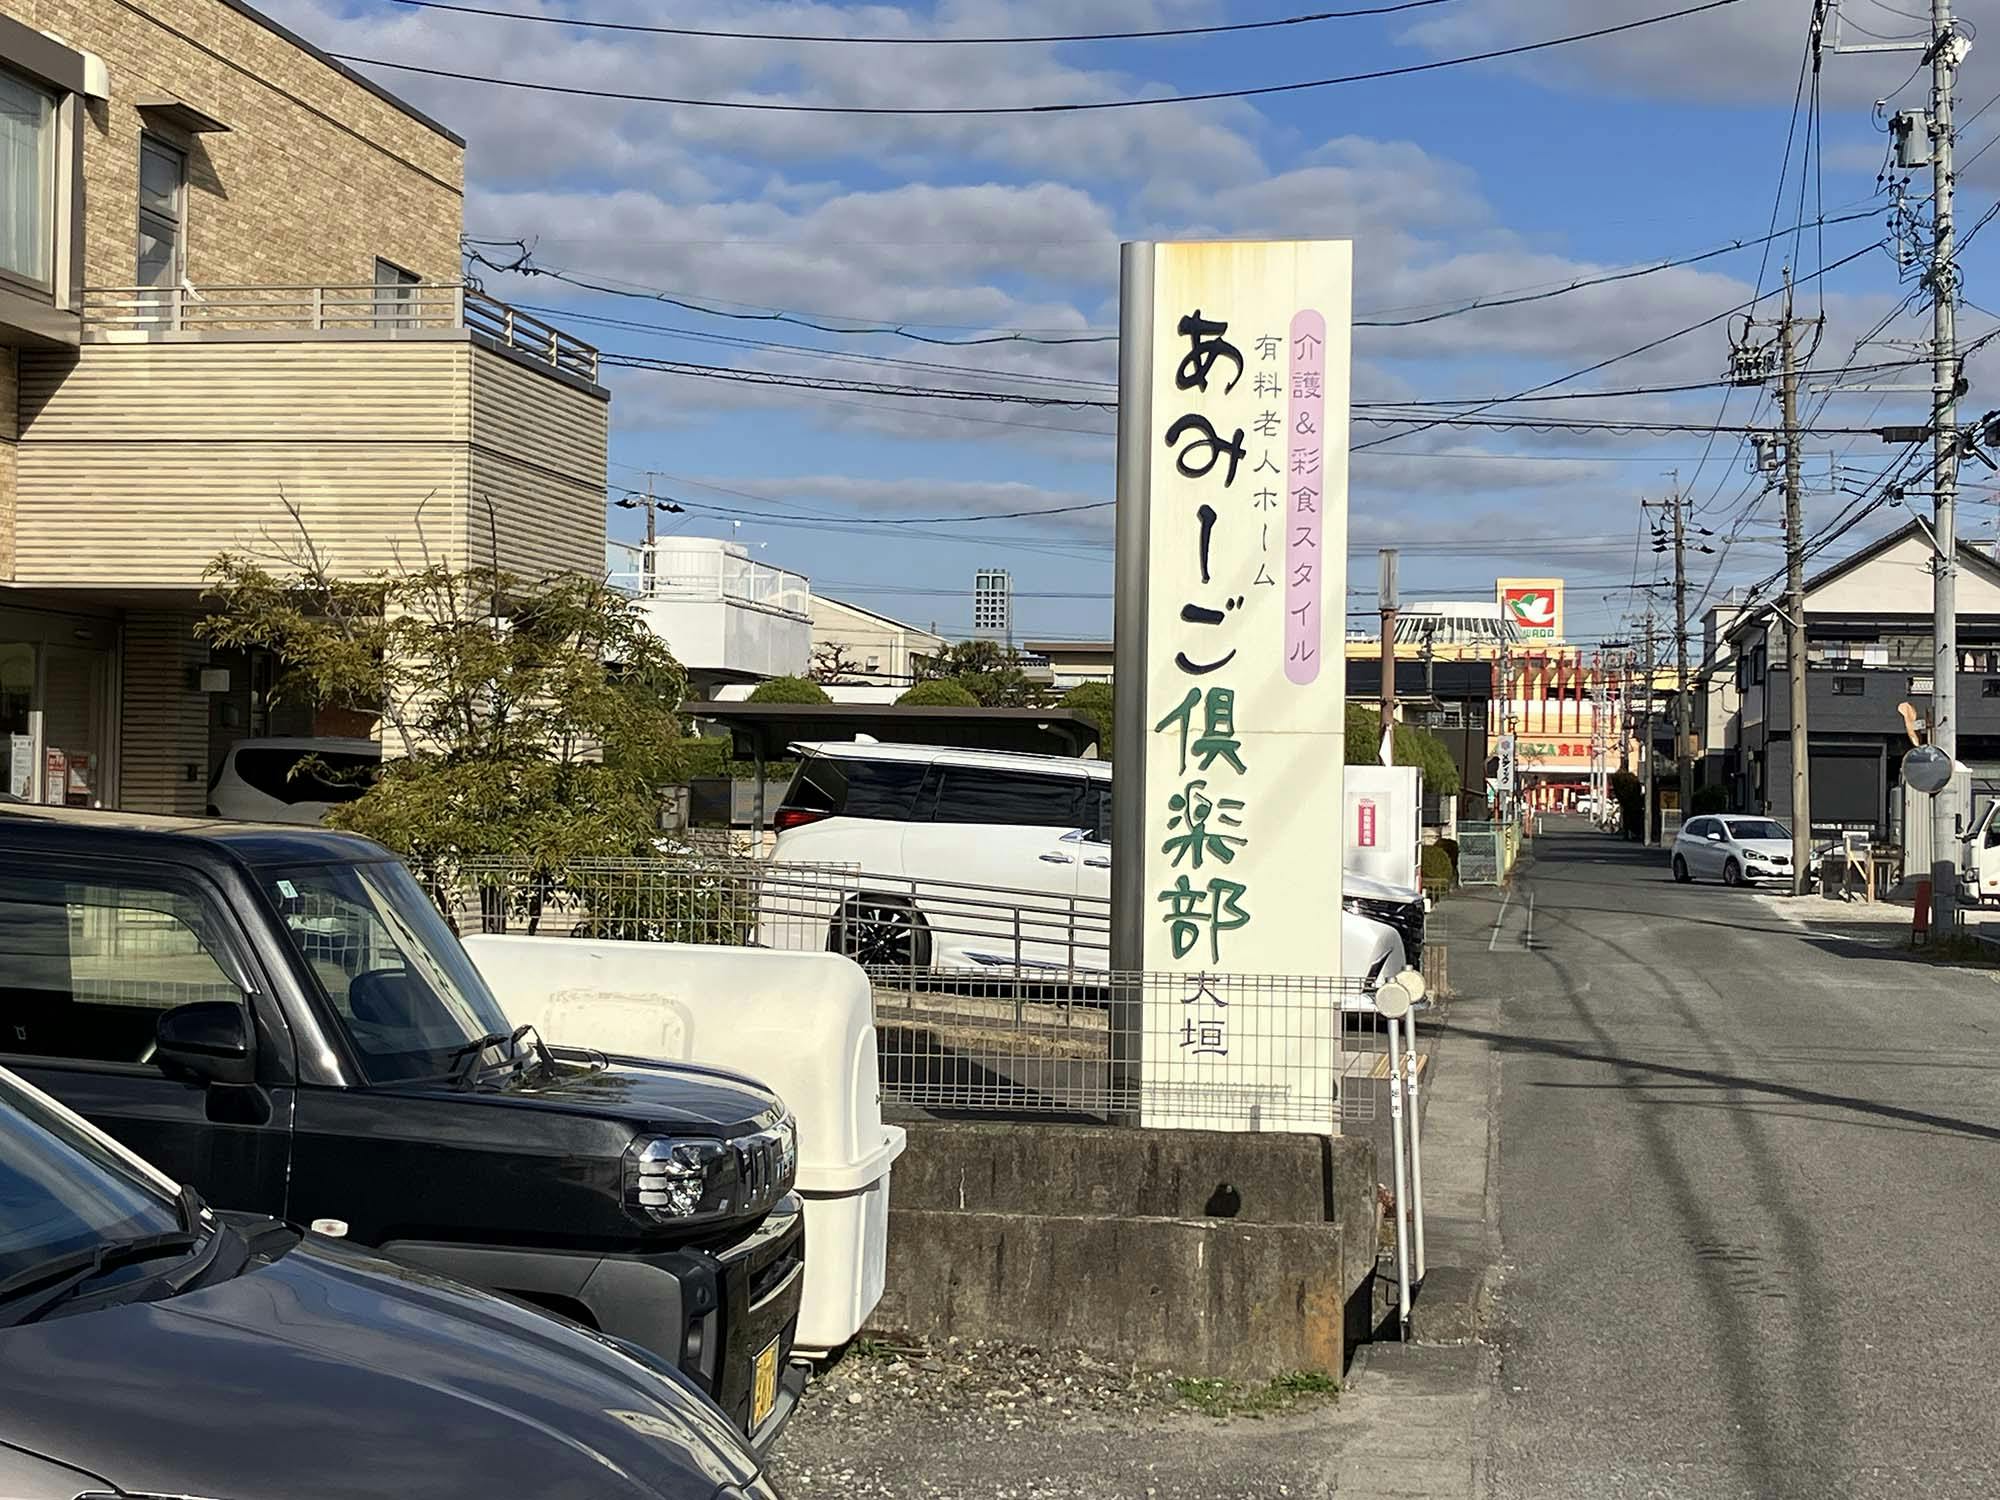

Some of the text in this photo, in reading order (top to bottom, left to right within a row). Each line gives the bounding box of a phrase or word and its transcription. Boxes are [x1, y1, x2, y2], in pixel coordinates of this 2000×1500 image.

[1252, 333, 1282, 587] 有料老人ホーム
[1289, 332, 1322, 662] 介護&彩食スタイル
[1179, 969, 1229, 1057] 大垣
